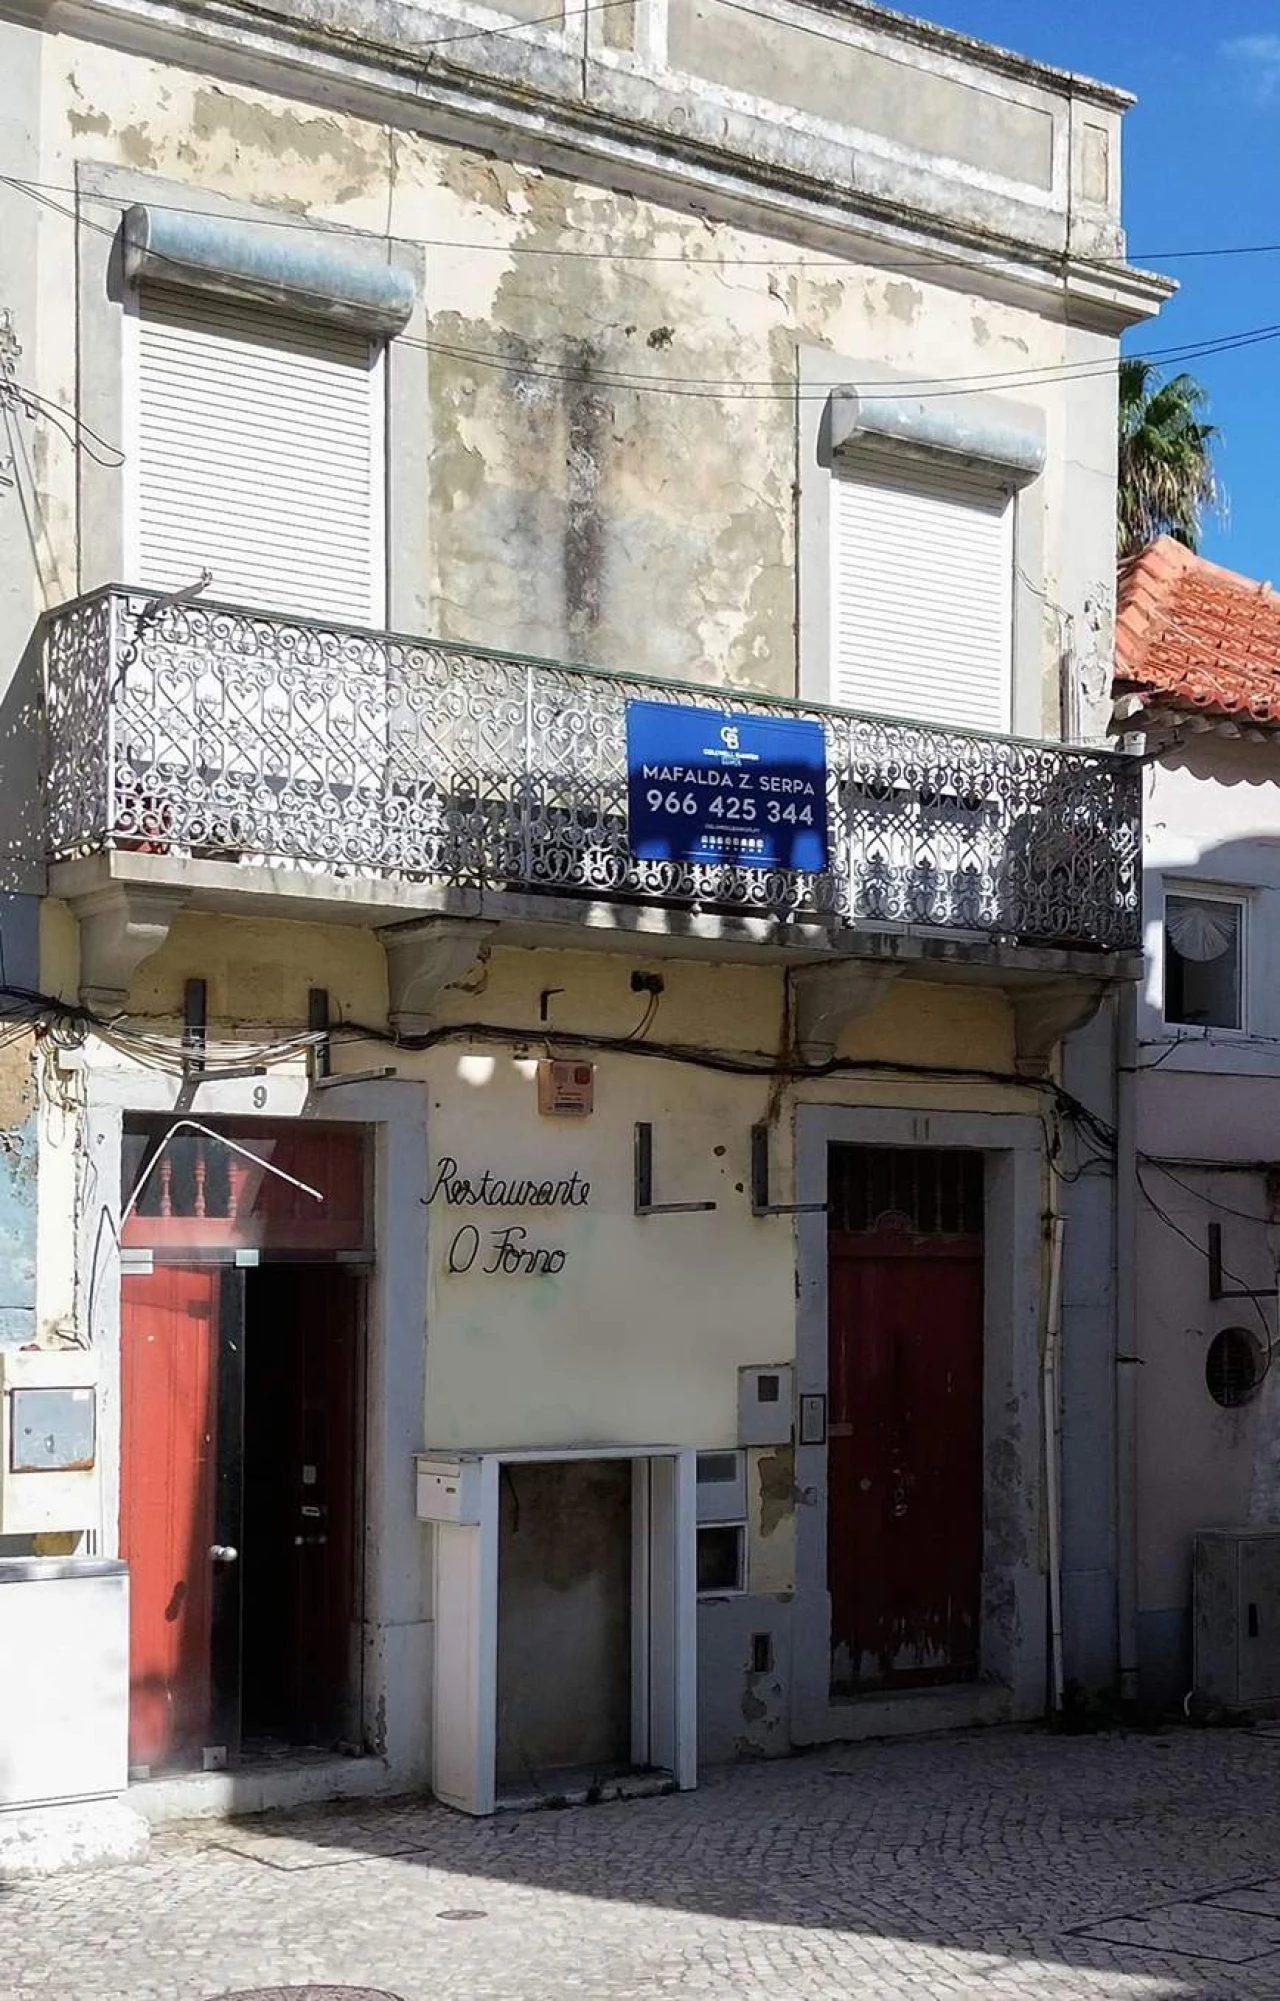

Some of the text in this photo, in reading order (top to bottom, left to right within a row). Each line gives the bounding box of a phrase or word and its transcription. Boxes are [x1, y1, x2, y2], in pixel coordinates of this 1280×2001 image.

[643, 764, 815, 796] MAFALDA Z SERPA
[646, 789, 814, 825] 966 425 344
[253, 1085, 268, 1109] 9
[420, 1157, 591, 1206] Restaurante
[448, 1224, 570, 1274] O Forno
